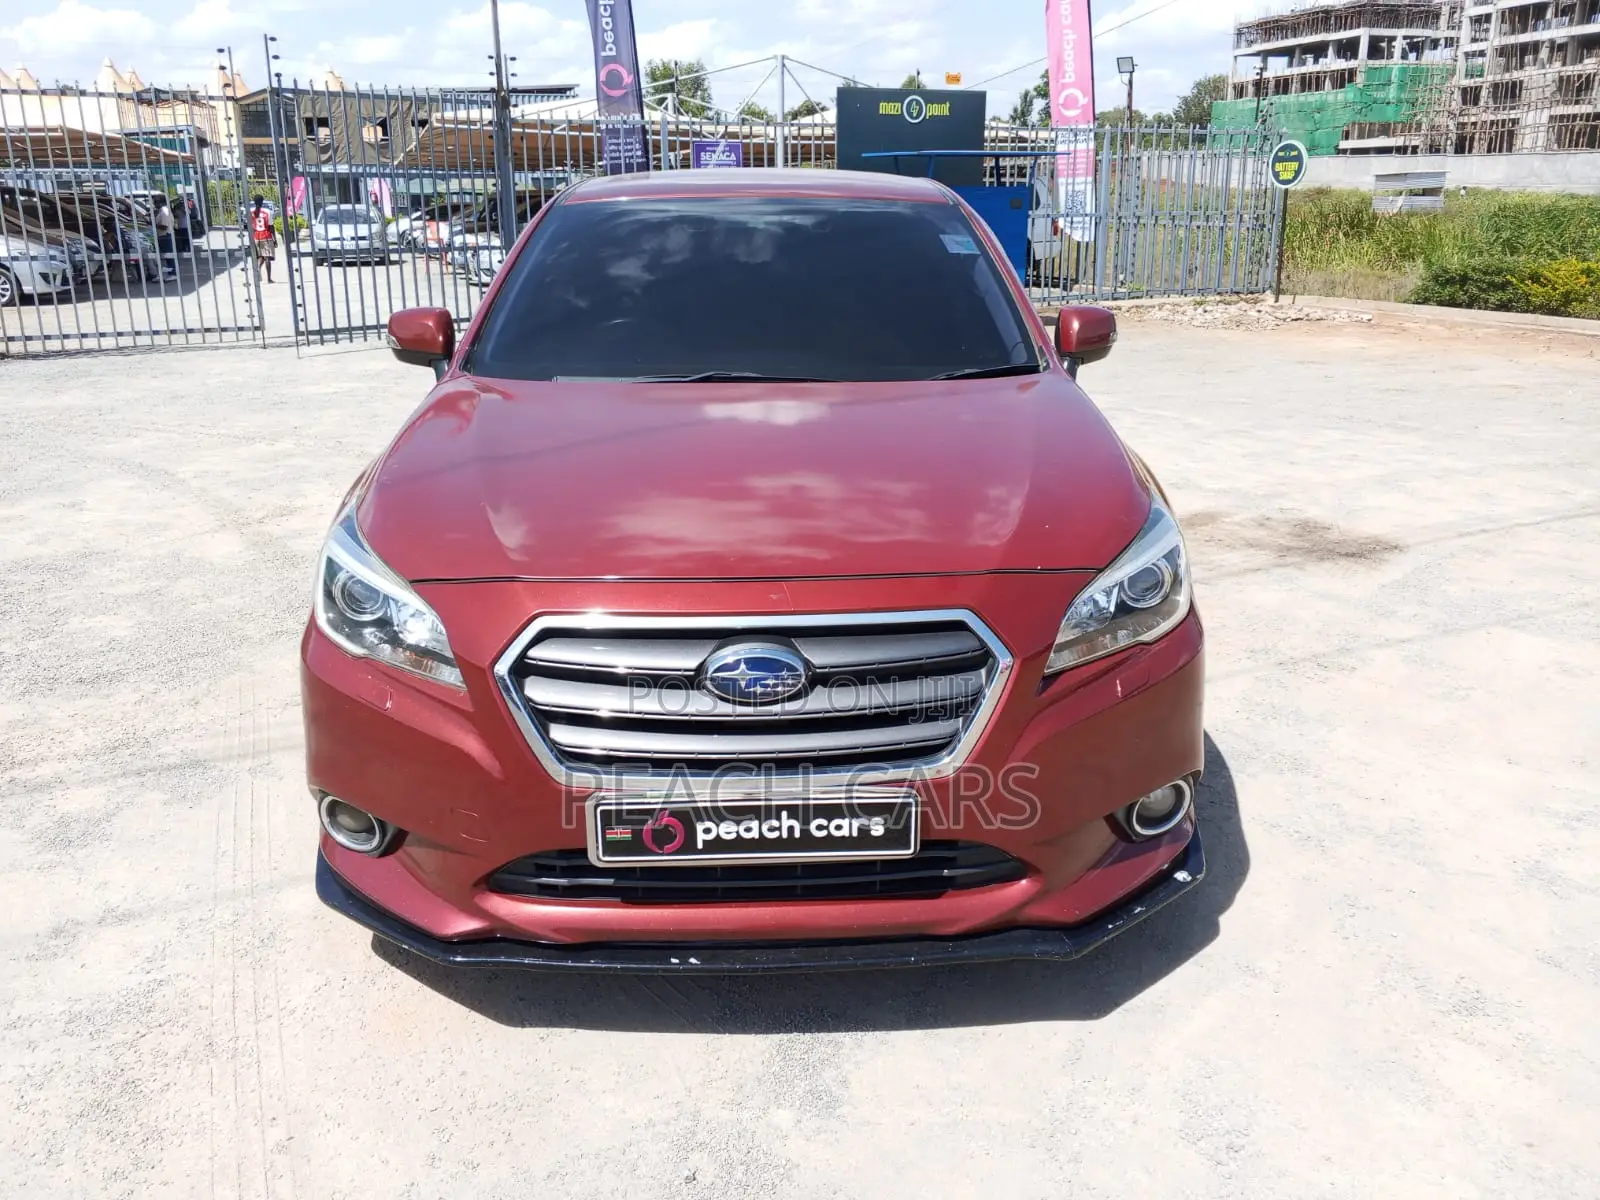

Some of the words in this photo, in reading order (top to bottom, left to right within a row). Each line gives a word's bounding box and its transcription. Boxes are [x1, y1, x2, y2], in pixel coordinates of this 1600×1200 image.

[926, 101, 950, 119] point
[696, 811, 801, 850] peach
[809, 814, 886, 838] cars
